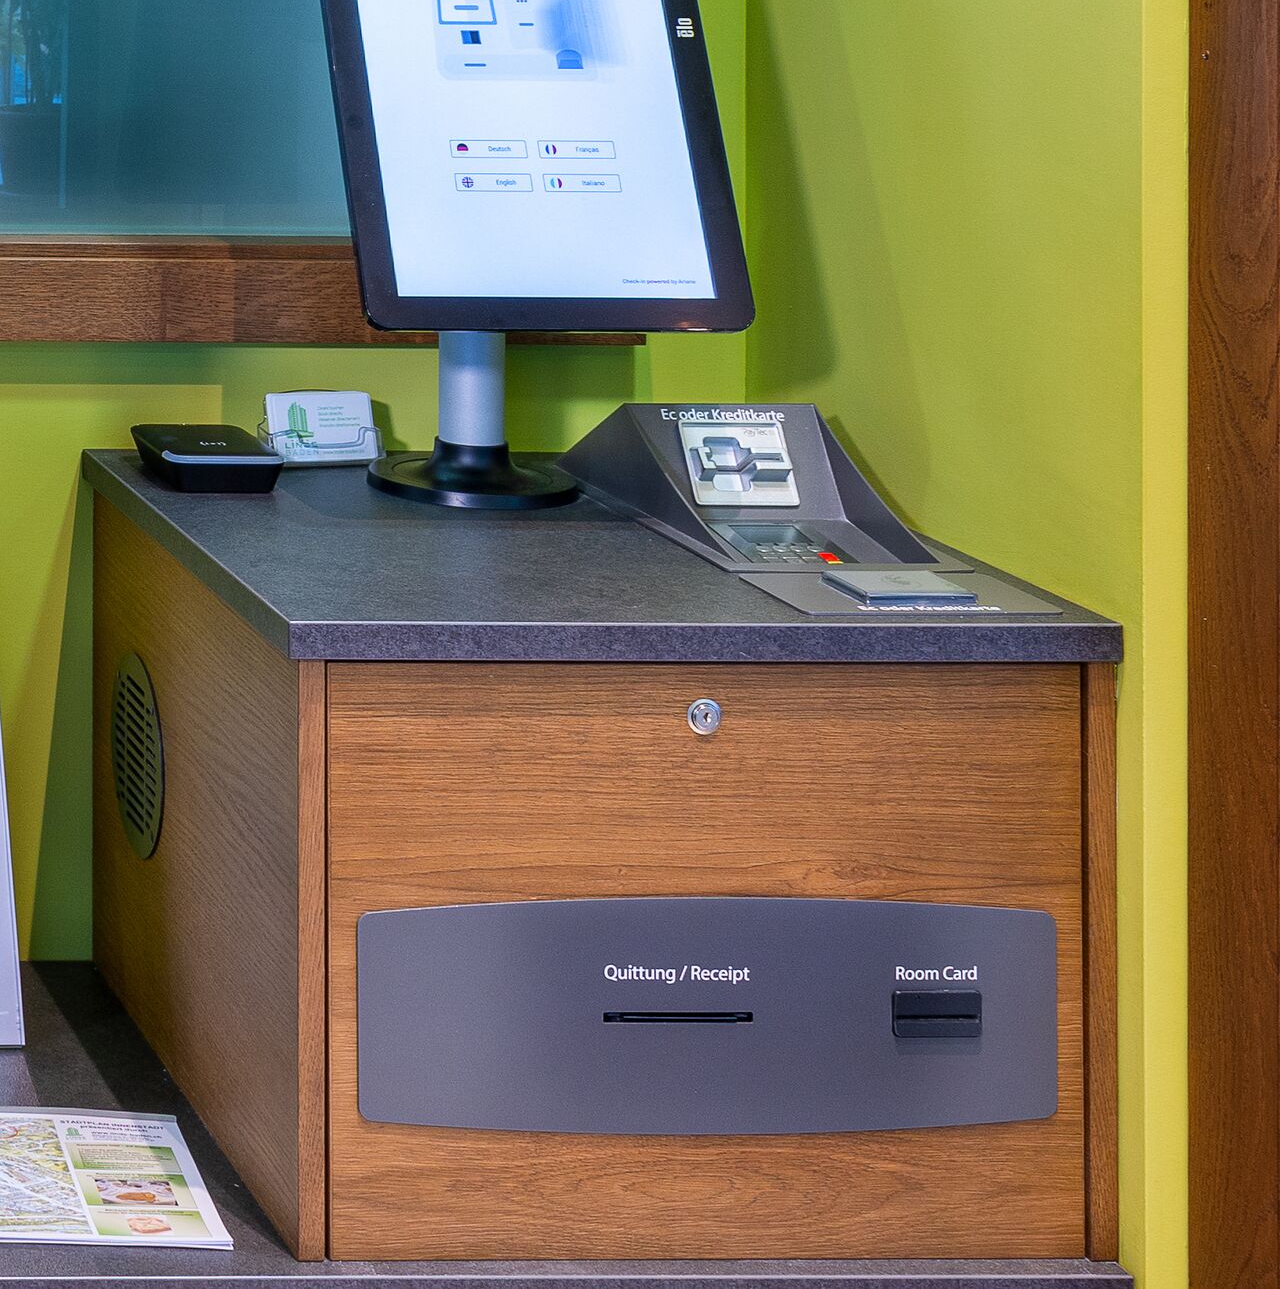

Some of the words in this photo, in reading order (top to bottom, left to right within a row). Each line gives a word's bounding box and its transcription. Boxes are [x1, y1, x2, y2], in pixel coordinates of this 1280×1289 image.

[496, 179, 516, 187] English
[660, 409, 677, 420] Ec
[678, 409, 709, 421] oder
[711, 409, 785, 421] Kreditkarte
[604, 964, 676, 984] Quittung
[680, 965, 688, 981] /
[691, 966, 750, 984] Receipt
[895, 966, 939, 981] Room
[942, 966, 978, 981] Card
